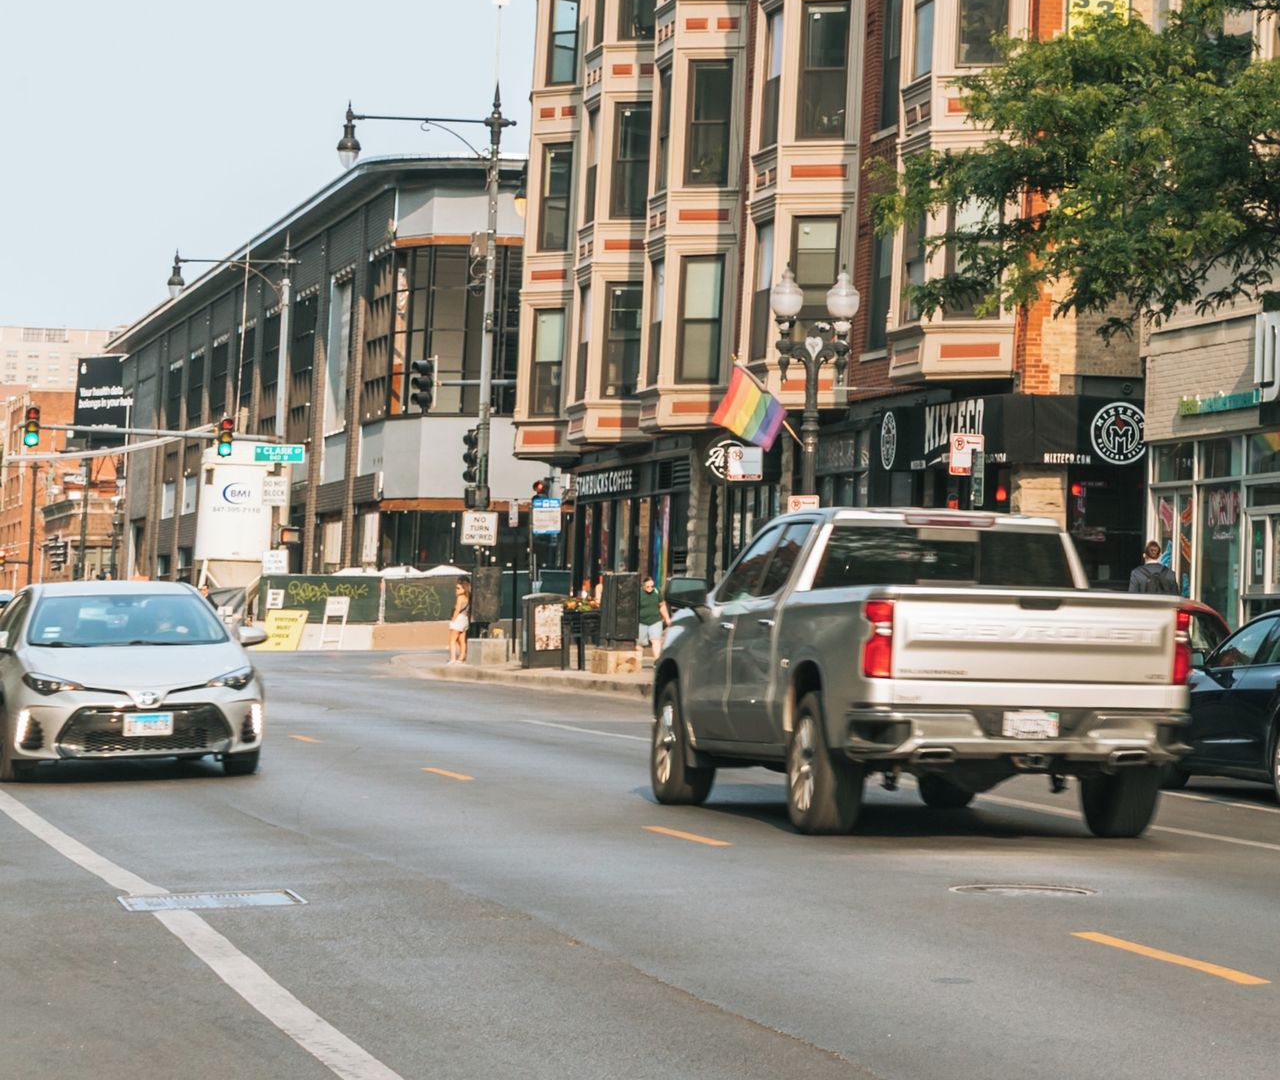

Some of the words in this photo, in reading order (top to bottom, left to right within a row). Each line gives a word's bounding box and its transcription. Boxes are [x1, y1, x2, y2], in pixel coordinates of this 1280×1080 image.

[1096, 406, 1145, 428] MIXTECO
[263, 446, 293, 455] CLARK
[1043, 452, 1091, 465] MIXTECO.COM
[576, 471, 608, 496] STARBUCKS
[609, 470, 633, 493] COFFEE
[230, 489, 251, 498] BMI
